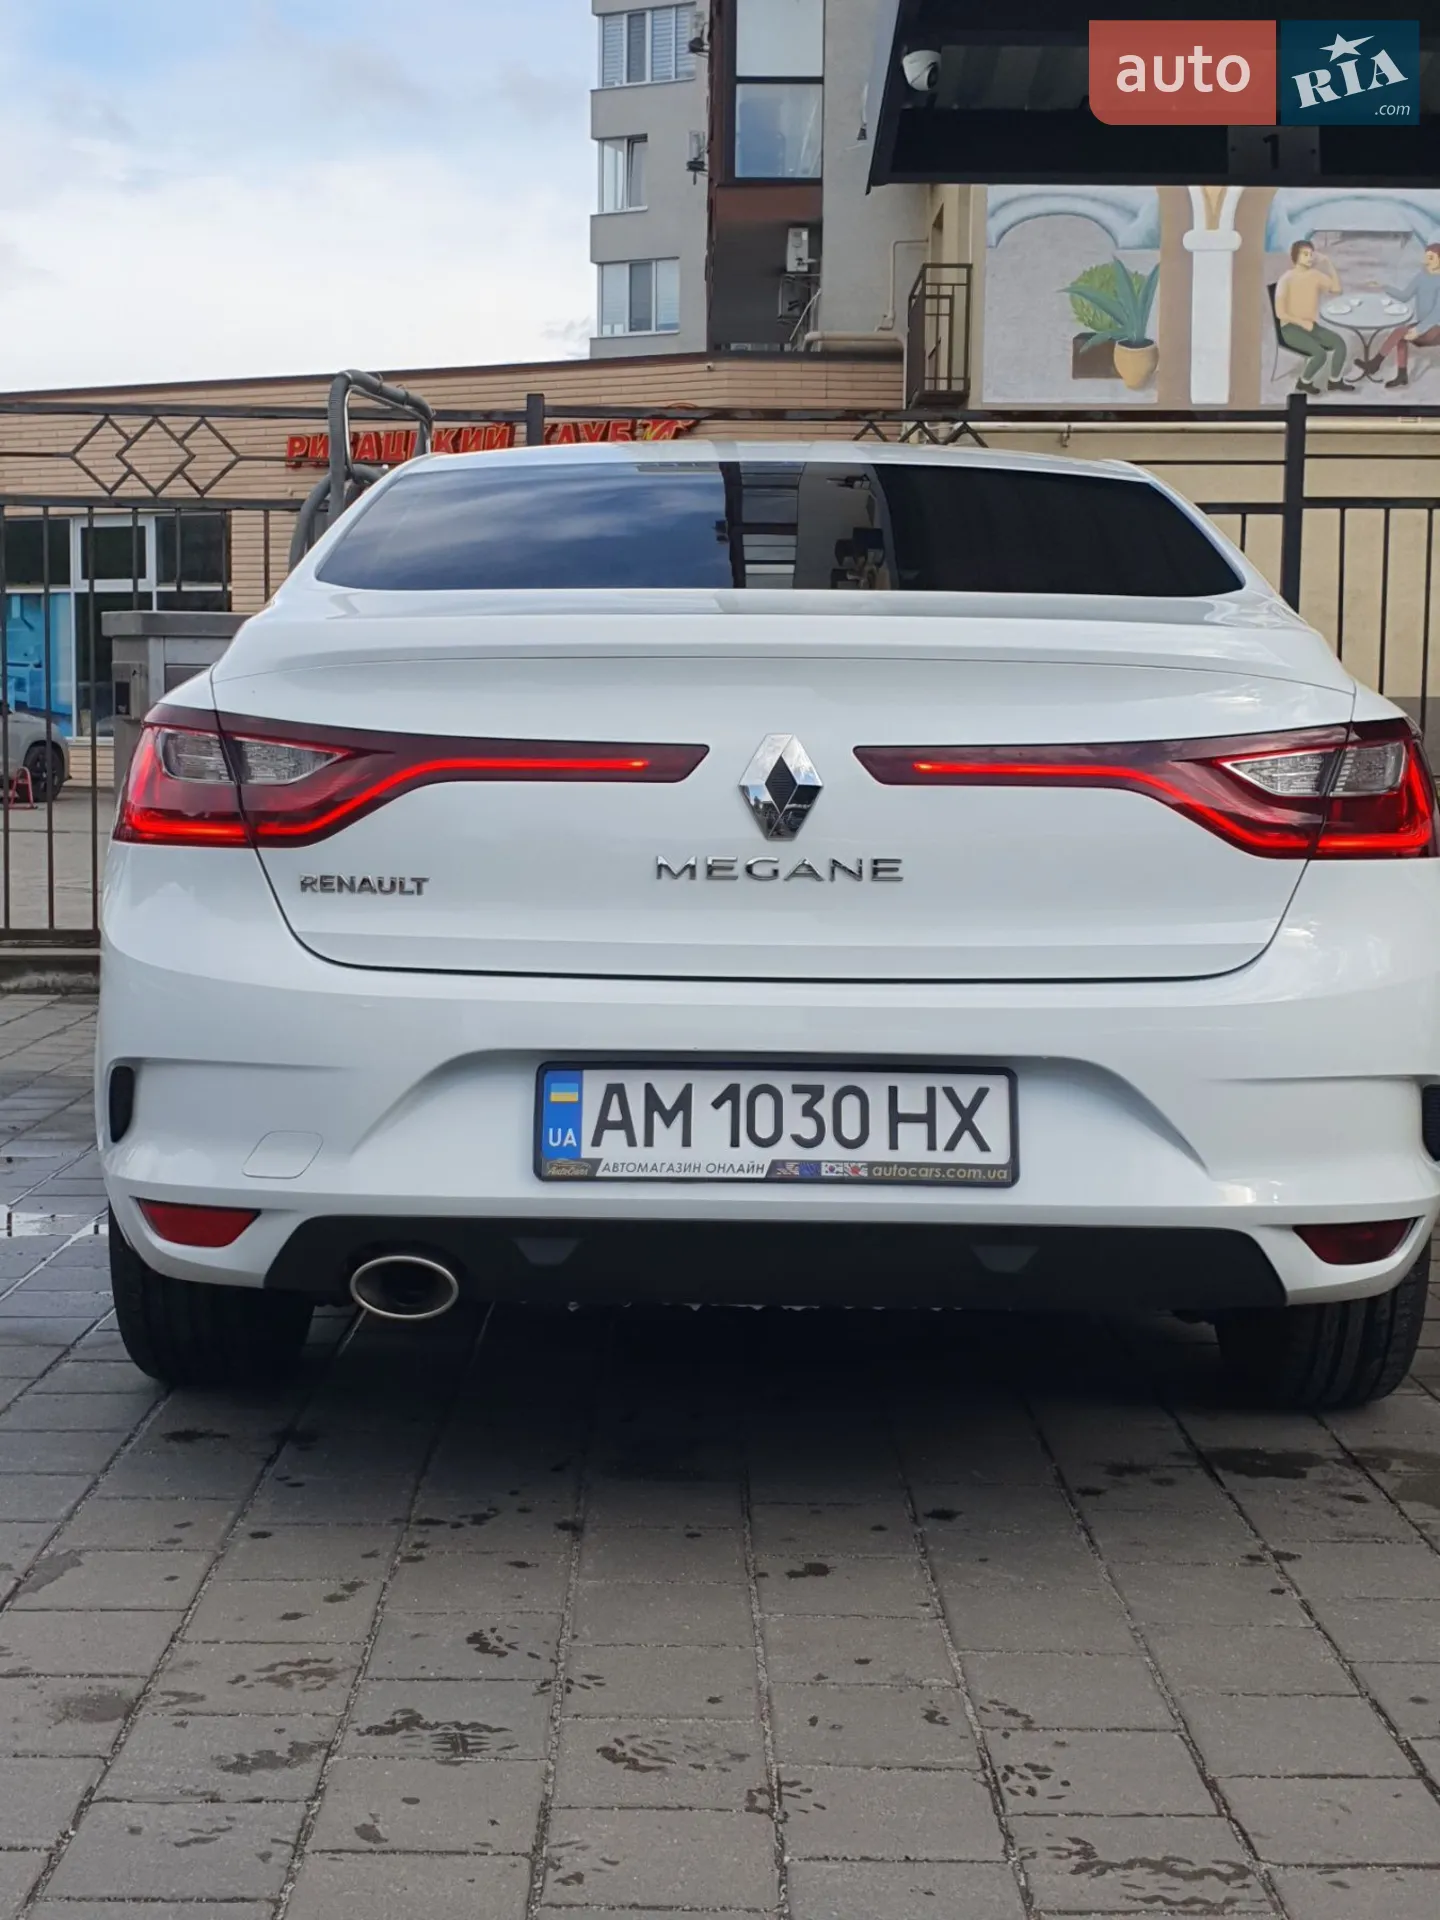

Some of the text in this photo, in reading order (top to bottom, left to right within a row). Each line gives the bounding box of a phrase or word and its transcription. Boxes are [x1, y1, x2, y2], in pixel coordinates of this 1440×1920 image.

[1262, 134, 1279, 170] 1
[656, 856, 904, 882] MEGANE
[299, 873, 431, 896] RENAULT
[590, 1082, 992, 1154] AM 1030 HX
[548, 1127, 577, 1148] UA
[601, 1160, 766, 1175] АВТОМАГАЗИН ОНЛАЙН
[871, 1163, 1009, 1181] autocars.com.ua
